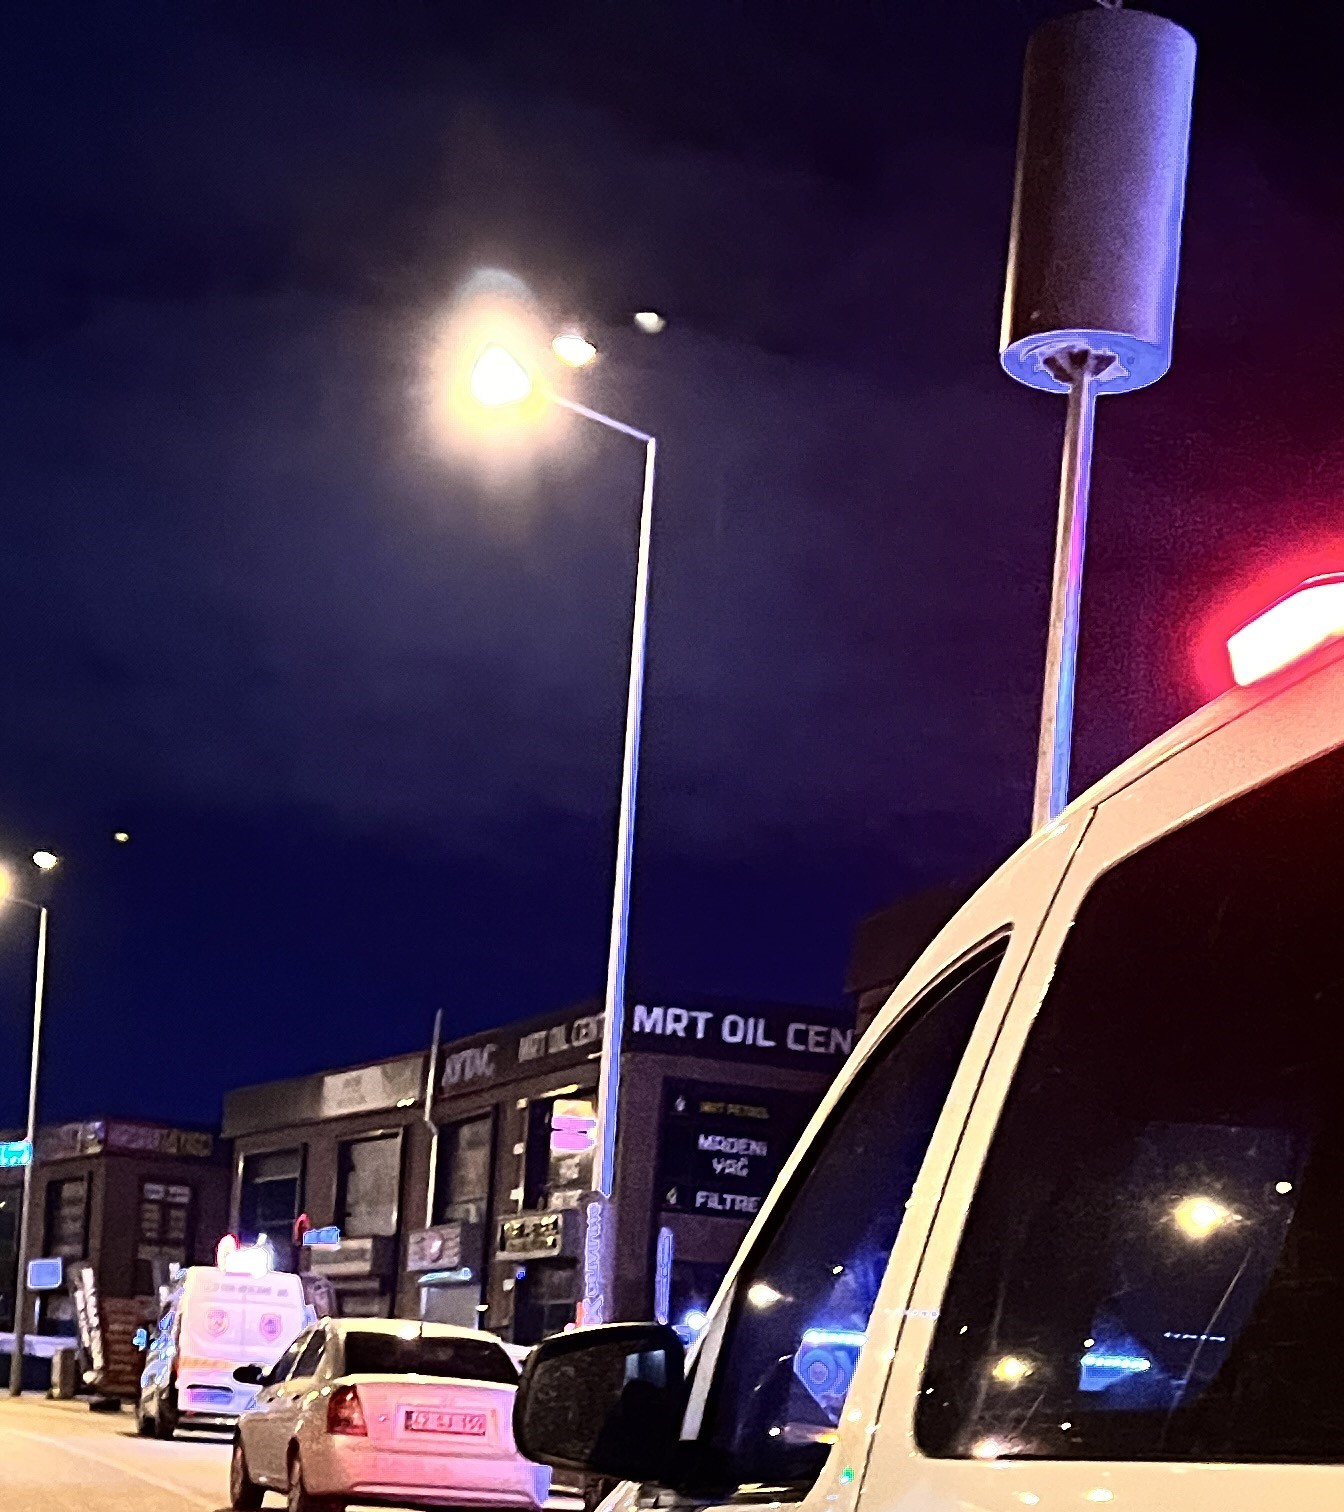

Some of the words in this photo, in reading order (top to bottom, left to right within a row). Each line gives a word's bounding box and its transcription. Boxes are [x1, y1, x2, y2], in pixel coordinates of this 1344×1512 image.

[633, 1005, 713, 1039] MRT
[721, 1014, 777, 1047] OIL
[786, 1022, 857, 1055] CEN
